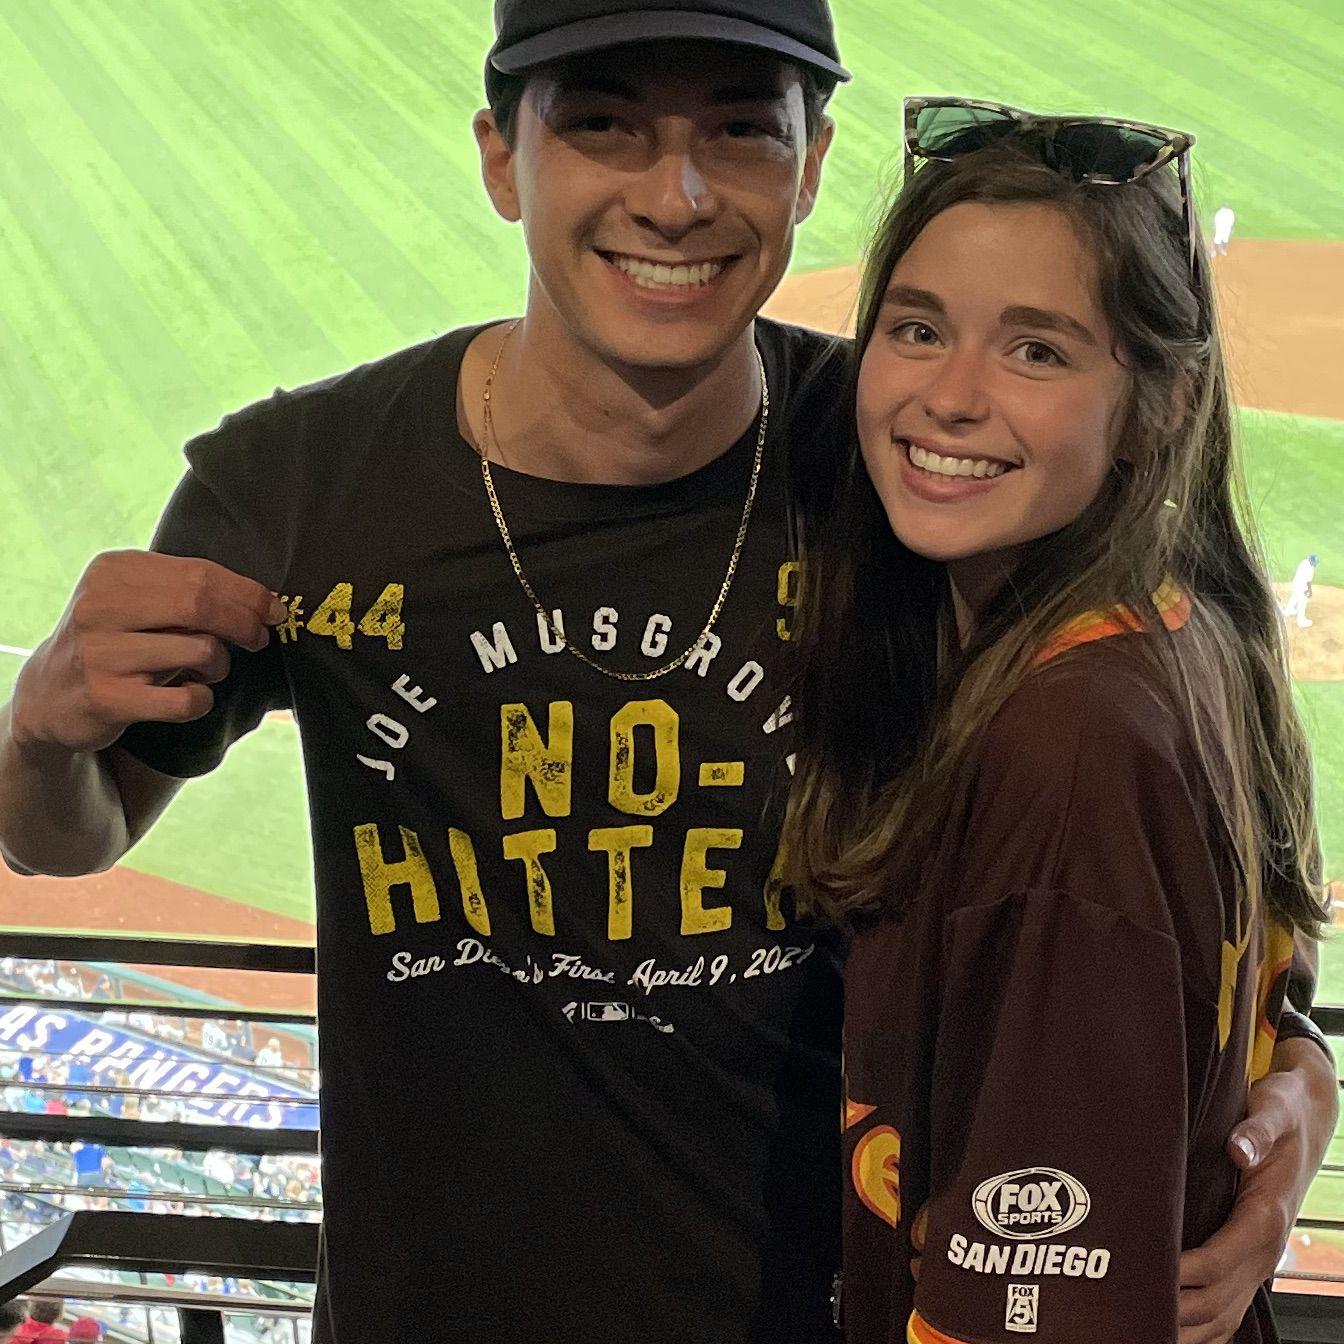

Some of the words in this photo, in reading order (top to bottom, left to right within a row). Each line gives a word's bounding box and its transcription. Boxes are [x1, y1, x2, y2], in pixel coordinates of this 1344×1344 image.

[275, 582, 406, 650] #44
[356, 672, 438, 782] JOE
[468, 605, 799, 777] MUSGROV
[500, 697, 746, 821] NO-
[387, 951, 445, 983] San
[628, 958, 703, 996] April
[709, 954, 738, 986] 9,
[997, 1211, 1063, 1225] SPORTS
[999, 1181, 1062, 1213] FOX
[947, 1233, 1011, 1275] SAN
[1010, 1243, 1111, 1280] DIEGO
[1012, 1286, 1035, 1298] FOX
